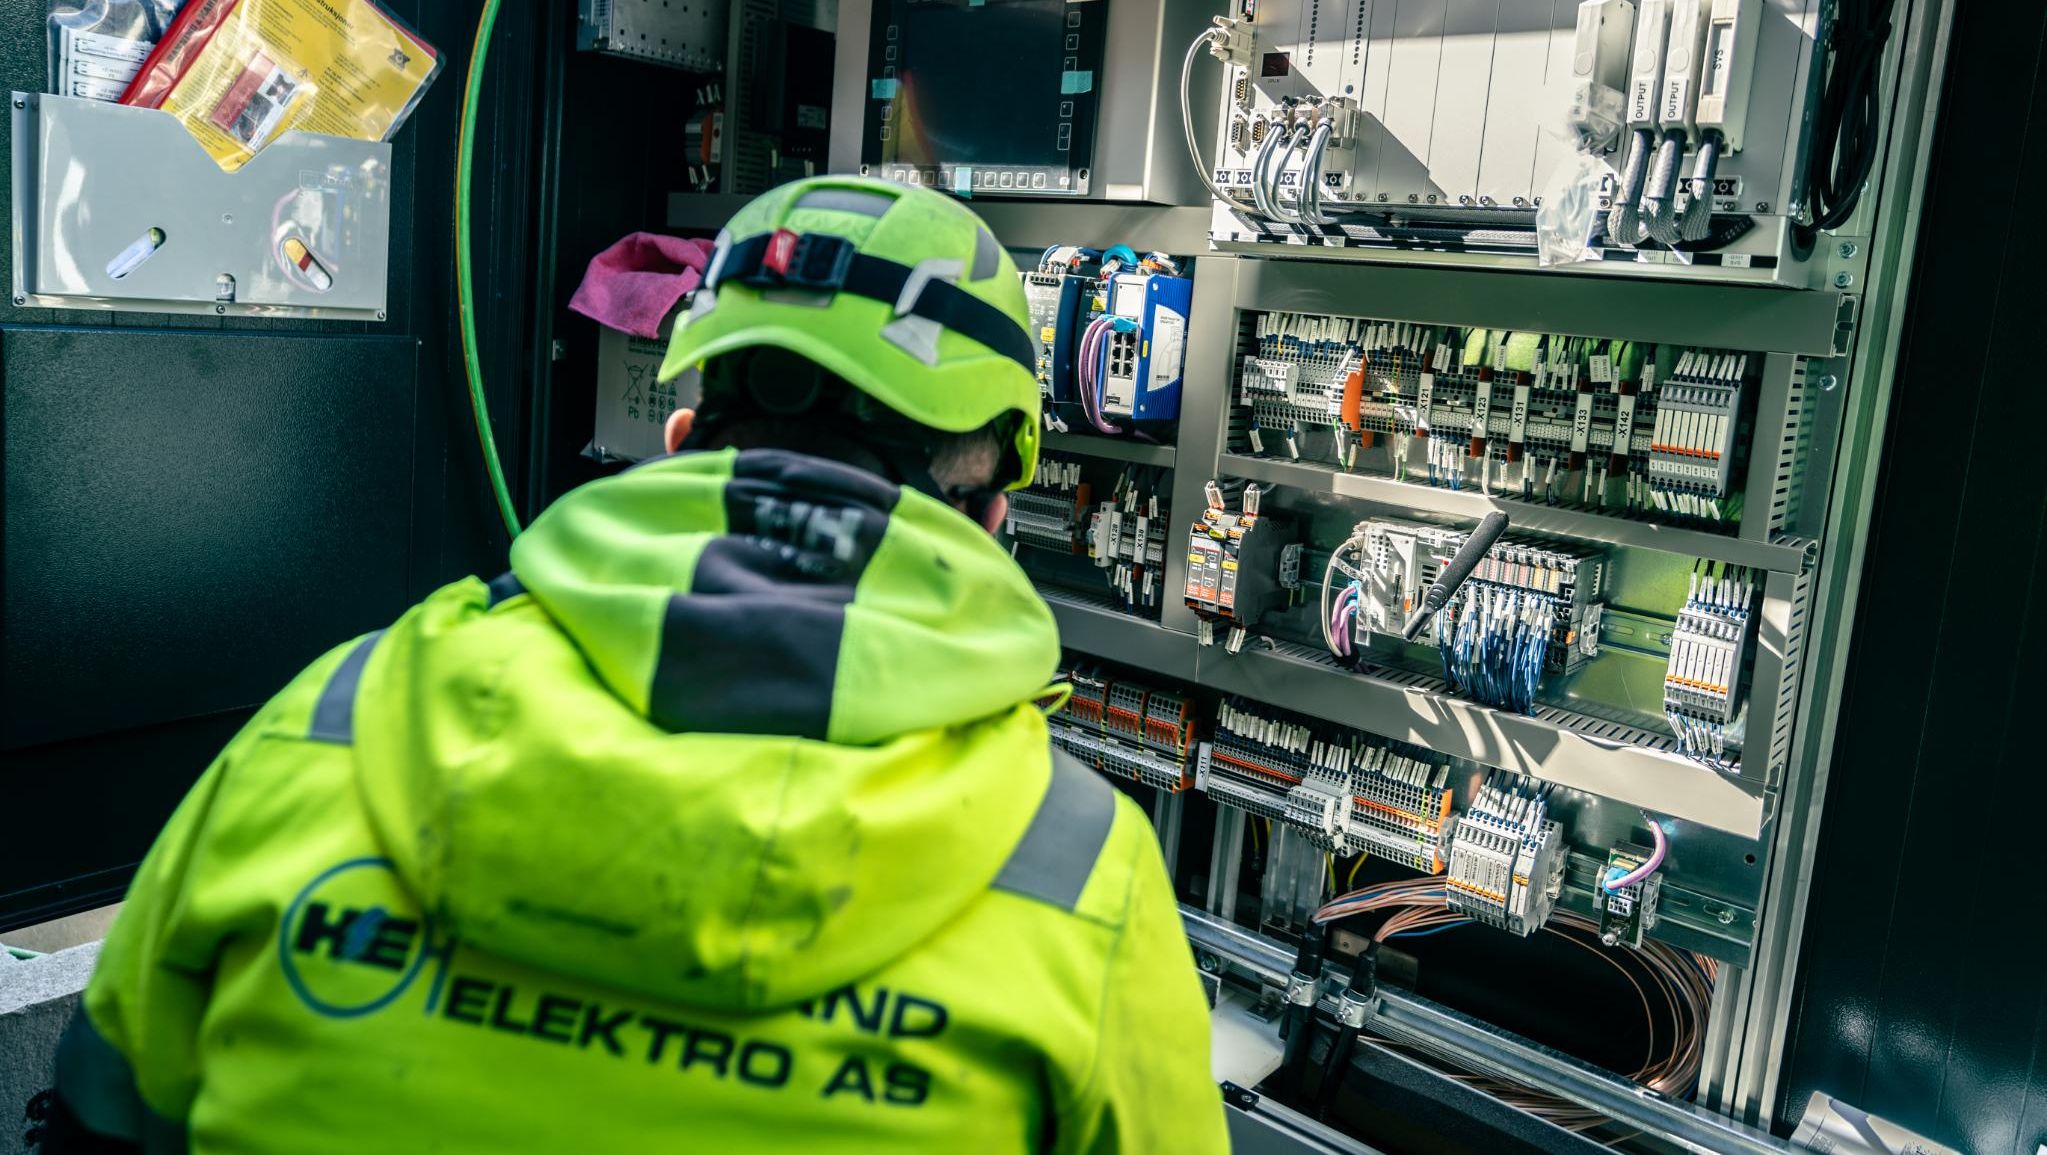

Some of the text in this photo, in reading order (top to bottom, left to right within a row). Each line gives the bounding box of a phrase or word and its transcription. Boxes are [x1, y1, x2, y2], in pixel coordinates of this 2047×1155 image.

[1635, 82, 1647, 119] OUTPUT
[1667, 81, 1680, 118] OUTPUT
[1419, 388, 1430, 413] -X121
[1475, 397, 1487, 422] -X123
[1513, 401, 1525, 427] -X131
[1576, 409, 1588, 437] -X133
[1617, 410, 1630, 438] -X142
[444, 975, 932, 1109] ELEKTRO AS
